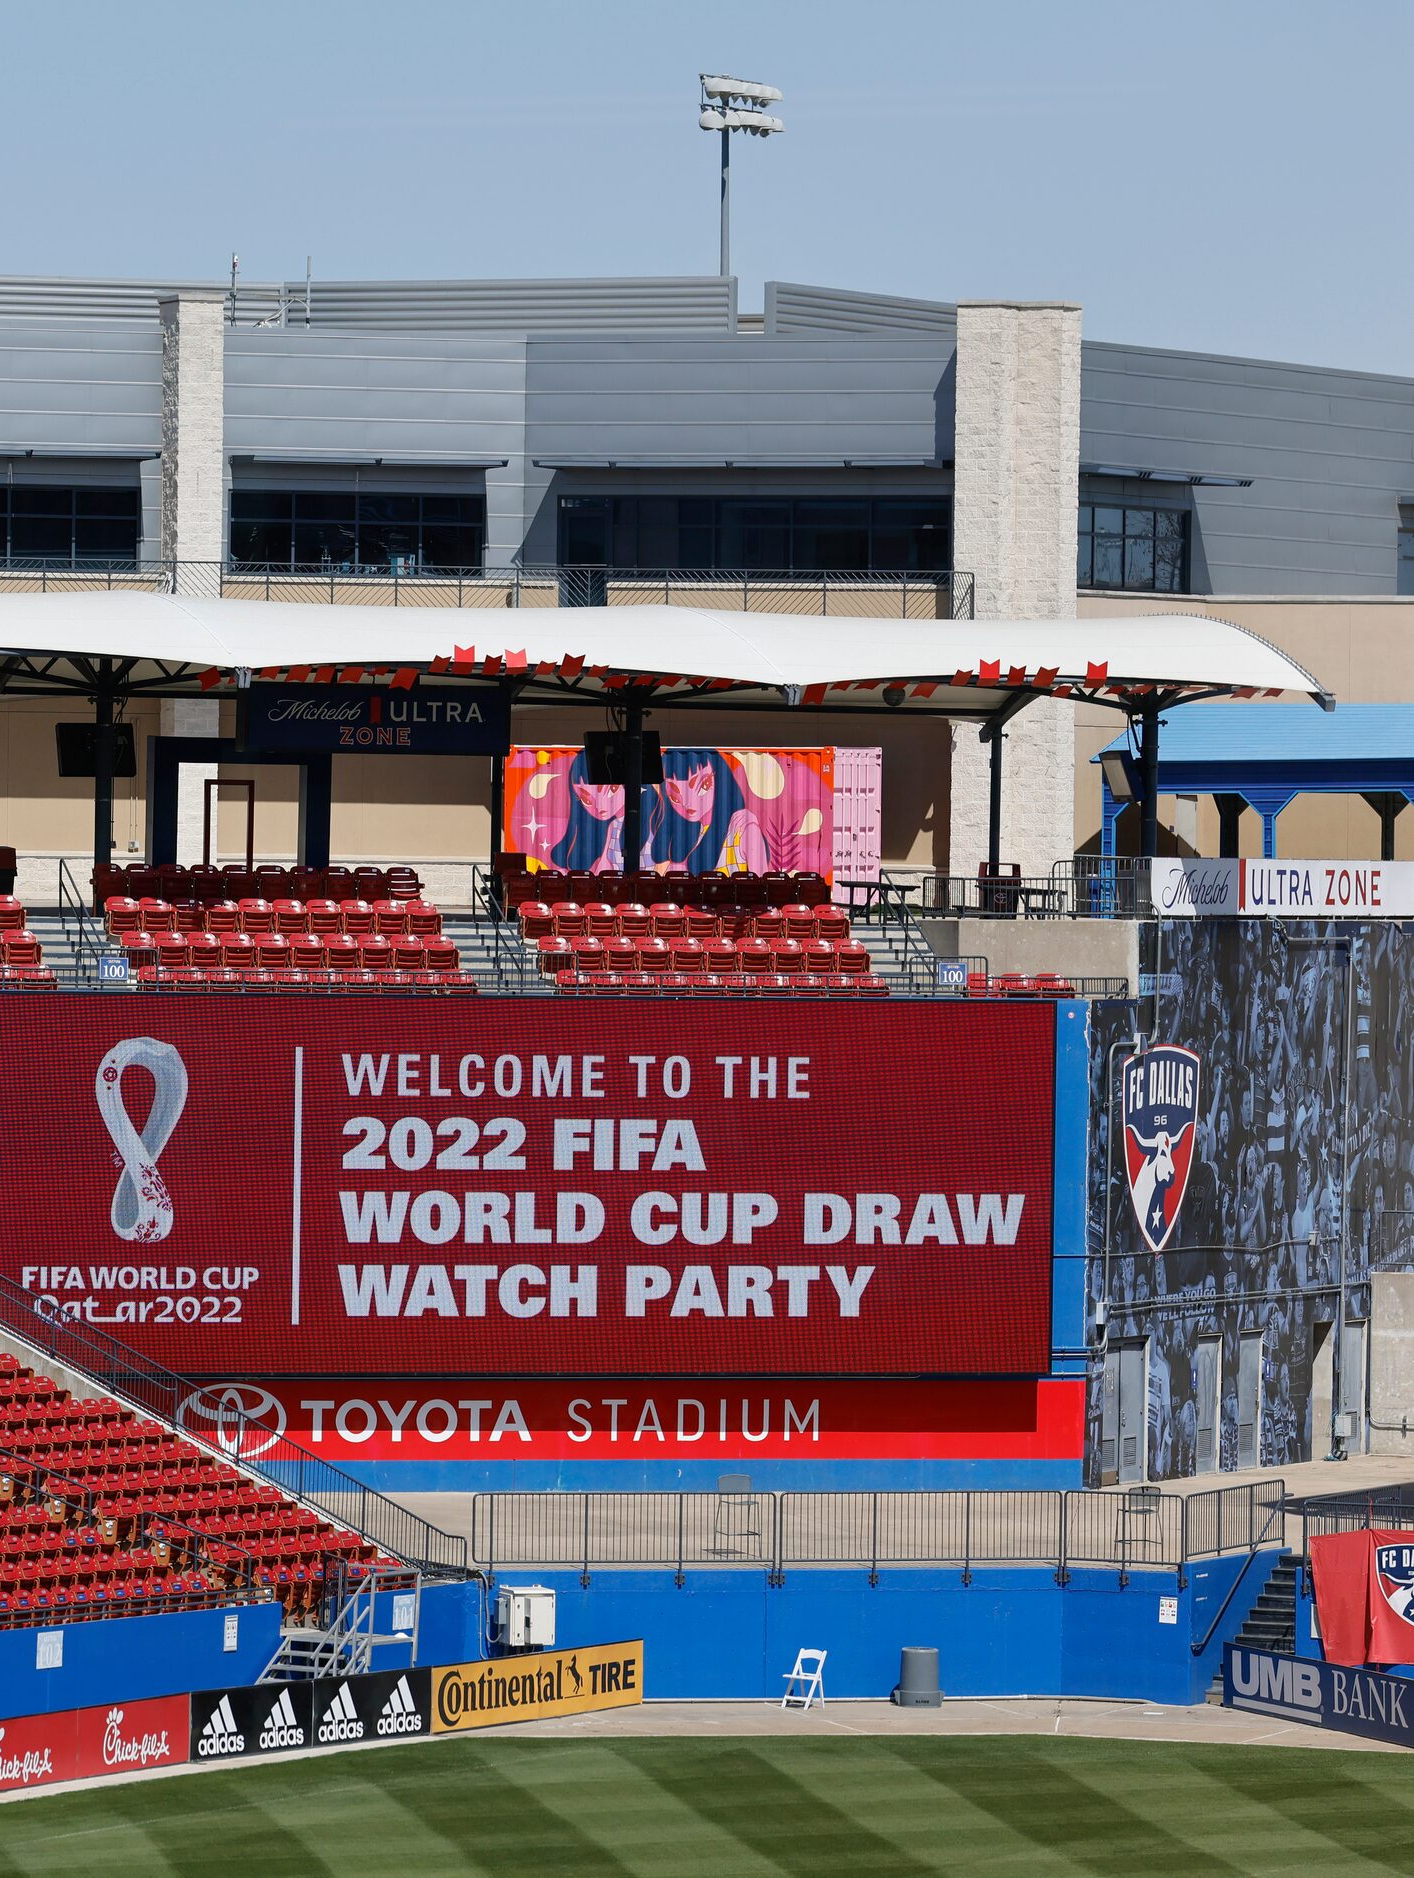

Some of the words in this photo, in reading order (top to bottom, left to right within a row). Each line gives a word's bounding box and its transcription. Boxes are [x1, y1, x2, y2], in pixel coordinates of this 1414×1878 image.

[266, 699, 366, 722] Michelob
[389, 701, 484, 723] ULTRA
[339, 726, 411, 746] ZONE
[1161, 868, 1232, 908] Michelob
[1251, 869, 1314, 906] ULTRA
[1325, 869, 1382, 907] ZONE
[103, 965, 125, 978] 100
[942, 970, 963, 983] 100
[342, 1053, 605, 1097] WELCOME
[628, 1055, 691, 1099] TO
[716, 1056, 810, 1099] THE
[1129, 1068, 1144, 1114] FC
[1149, 1060, 1193, 1109] DALLAS
[1154, 1115, 1168, 1126] 96
[342, 1117, 527, 1171] 2022
[553, 1118, 707, 1171] FIFA
[338, 1191, 606, 1245] WORLD
[630, 1191, 779, 1245] CUP
[803, 1193, 1026, 1245] DRAW
[22, 1266, 86, 1290] FIFA
[89, 1266, 197, 1290] WORLD
[202, 1266, 260, 1290] CUP
[338, 1265, 598, 1318] WATCH
[625, 1265, 875, 1317] PARTY
[300, 1399, 533, 1442] TOYOTA
[566, 1398, 819, 1443] STADIUM
[1381, 1549, 1397, 1569] FC
[394, 1606, 414, 1628] 101
[39, 1643, 61, 1667] 102
[437, 1660, 563, 1727] Continental
[589, 1658, 636, 1695] TIRE
[1231, 1650, 1323, 1709] UMB
[1332, 1669, 1409, 1729] BANK
[318, 1718, 364, 1742] adidas
[377, 1711, 422, 1736] adidas
[102, 1716, 170, 1766] Chick-fil-A
[198, 1732, 245, 1756] adidas
[259, 1725, 304, 1750] adidas
